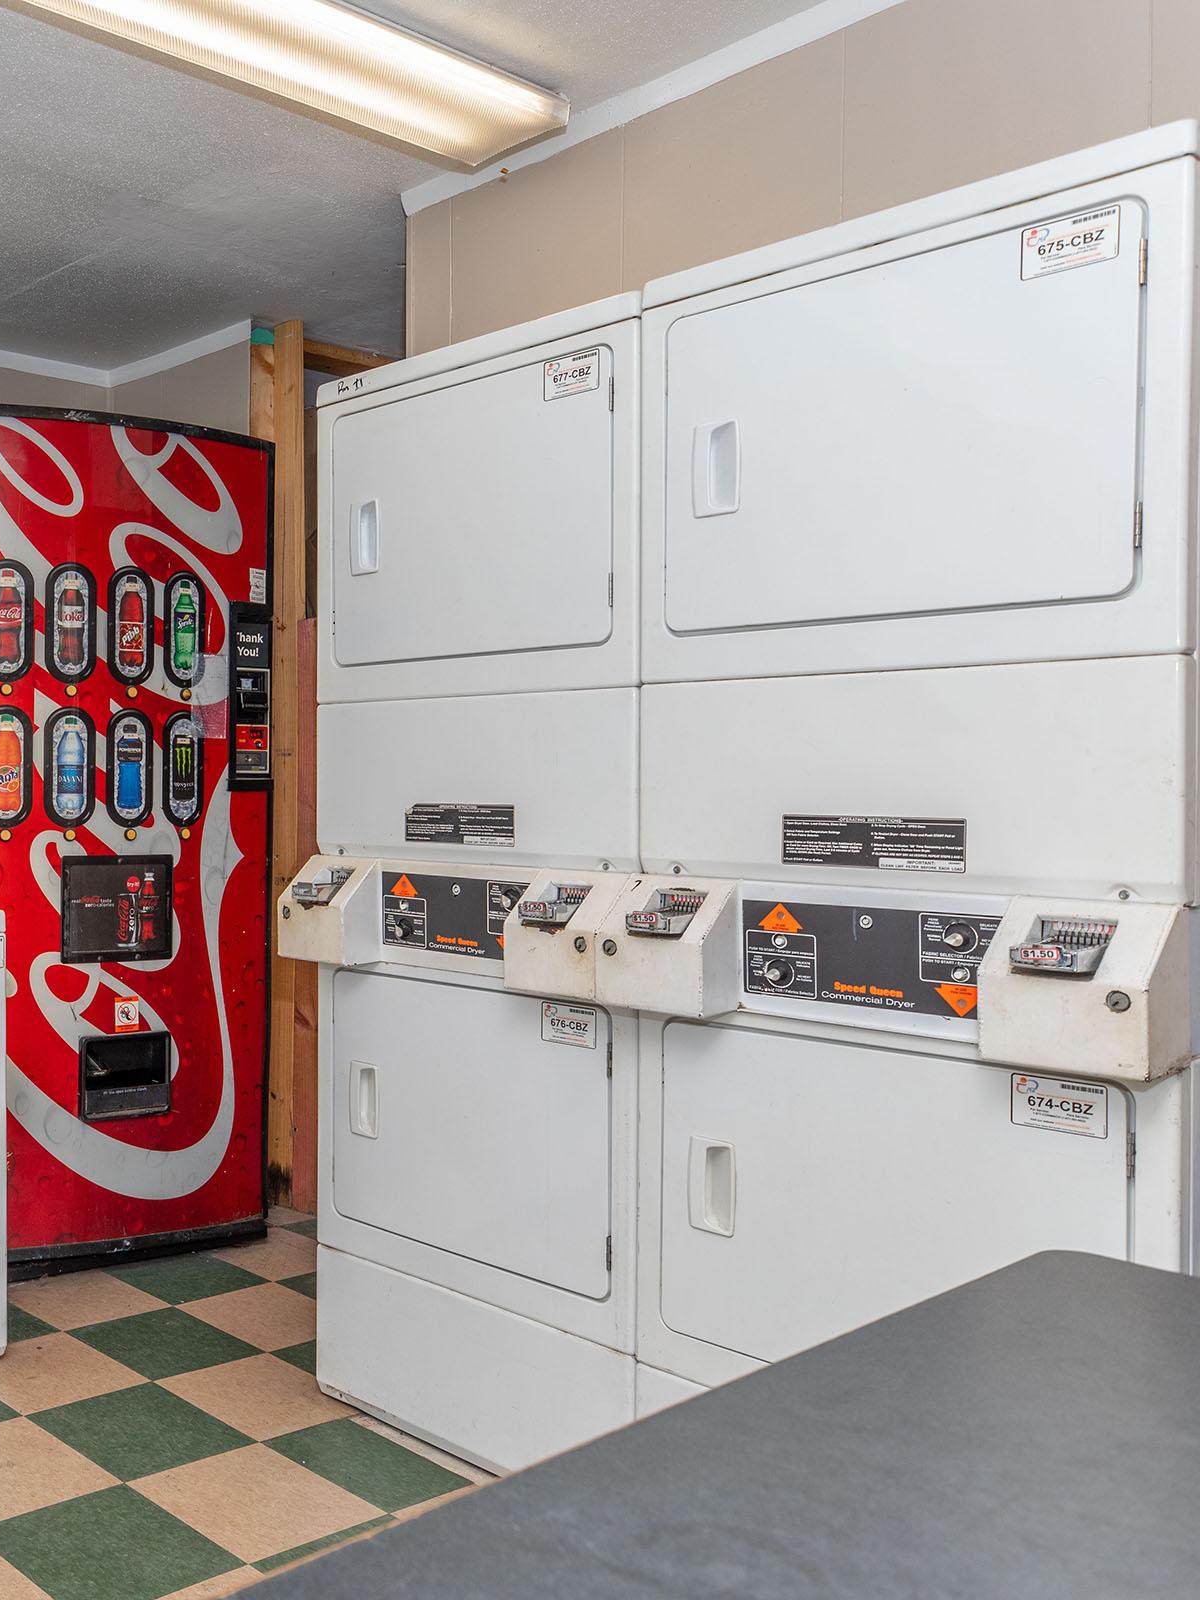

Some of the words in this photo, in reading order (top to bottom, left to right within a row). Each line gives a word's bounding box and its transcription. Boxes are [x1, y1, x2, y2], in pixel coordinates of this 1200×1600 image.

[1038, 229, 1104, 255] 675-CBZ
[553, 366, 591, 383] 677-CBZ
[177, 618, 193, 629] Sprite
[122, 626, 140, 646] Pibb
[237, 646, 259, 656] You!
[523, 903, 542, 912] $1.50
[633, 914, 654, 922] $1.50
[436, 934, 456, 944] Speed
[458, 938, 478, 947] Queen
[428, 942, 466, 952] Commercial
[467, 945, 486, 955] Dryer
[1023, 950, 1054, 958] $1.50
[834, 981, 866, 993] Speed
[870, 985, 903, 998] Queen
[821, 991, 882, 1004] Commercial
[886, 998, 915, 1008] Dryer
[551, 1018, 588, 1032] 676-CBZ
[1028, 1096, 1094, 1115] 674-CBZ
